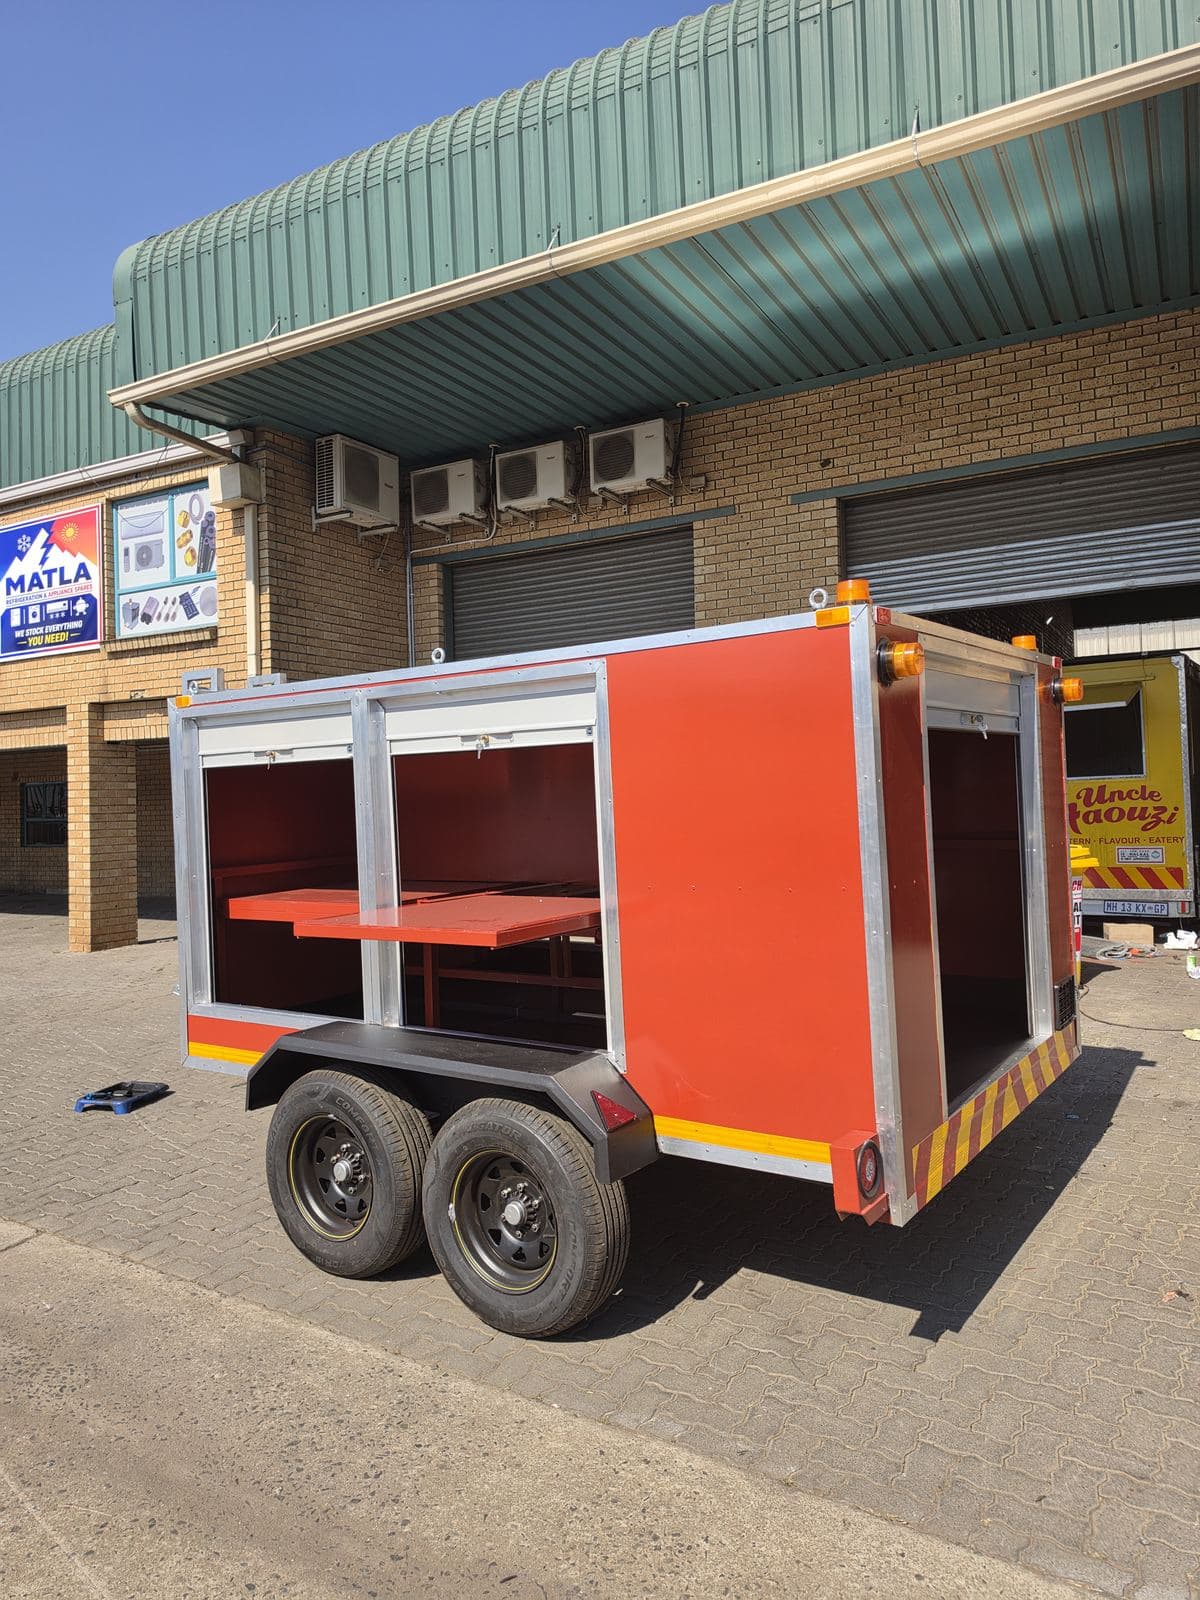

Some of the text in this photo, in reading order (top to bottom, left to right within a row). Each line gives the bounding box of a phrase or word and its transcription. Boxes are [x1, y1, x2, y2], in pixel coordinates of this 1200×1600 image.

[6, 562, 92, 596] MATLA
[6, 593, 43, 605] REFRIGERATION
[47, 588, 73, 597] APPLIANCE
[74, 584, 93, 593] SPARES
[15, 620, 83, 638] WE STOCK EVERYTHING
[28, 631, 69, 647] YOU NEED!
[1076, 784, 1163, 808] Uncle
[1098, 836, 1141, 845] FLAVOUR
[1148, 835, 1185, 844] EATERY
[1105, 901, 1166, 914] MH 13 KX GP
